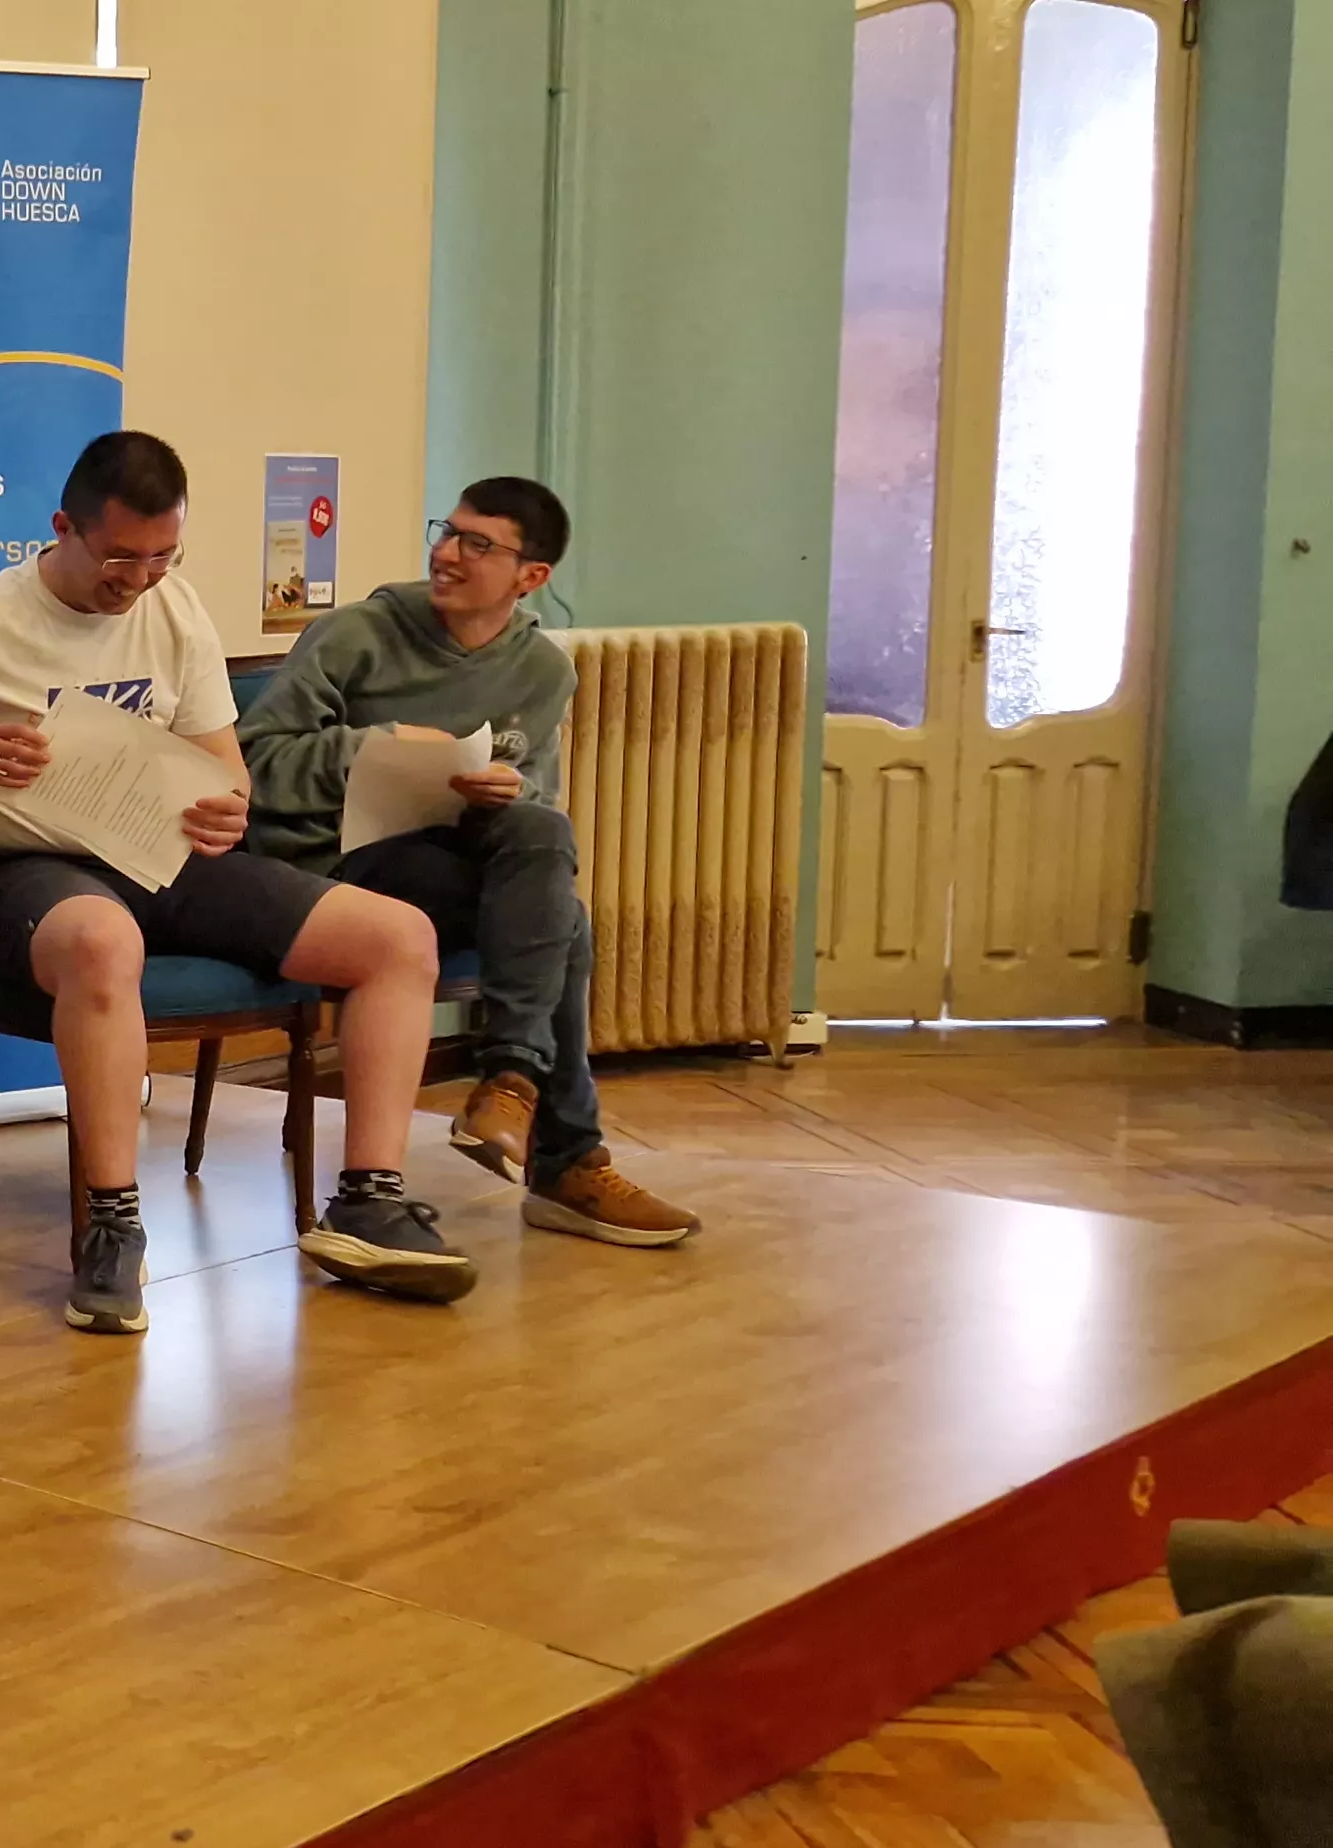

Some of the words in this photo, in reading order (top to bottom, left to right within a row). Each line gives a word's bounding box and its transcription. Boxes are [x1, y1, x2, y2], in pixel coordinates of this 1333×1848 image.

[1, 159, 103, 181] Asociación
[2, 182, 65, 200] DOWN
[2, 203, 81, 222] HUESCA
